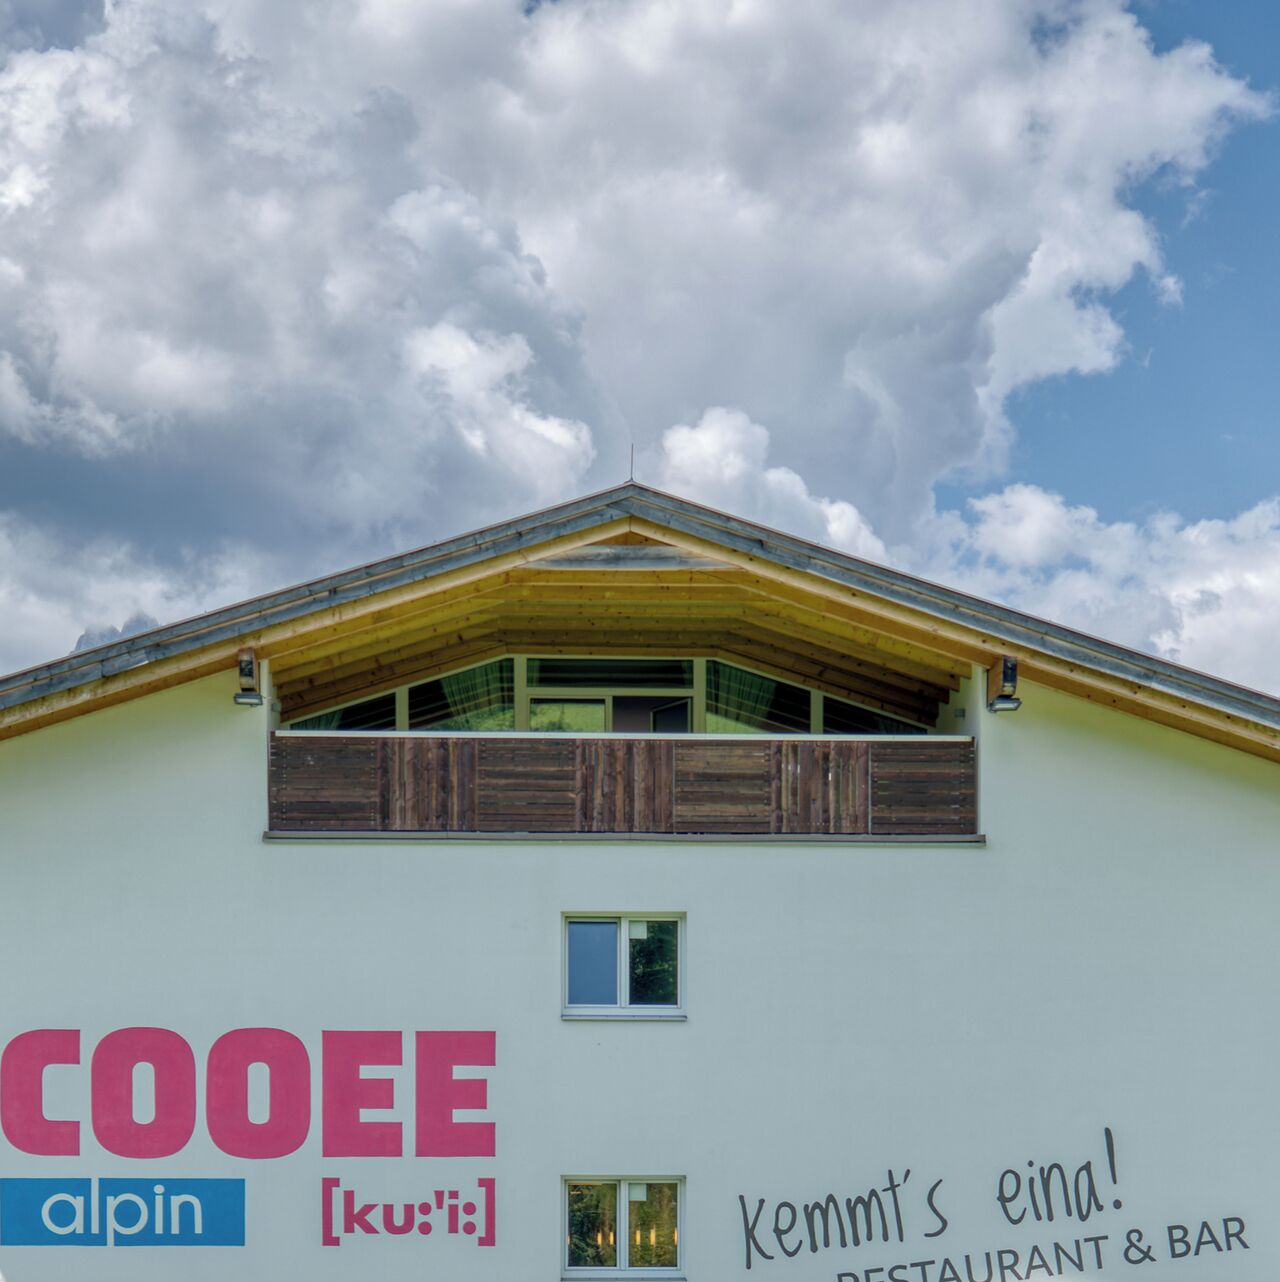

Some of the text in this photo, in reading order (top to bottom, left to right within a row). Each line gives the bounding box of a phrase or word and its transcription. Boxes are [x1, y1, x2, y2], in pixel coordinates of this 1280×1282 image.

[0, 1026, 497, 1160] COOEE
[40, 1177, 204, 1248] alpin
[996, 1126, 1123, 1226] eina!
[1123, 1228, 1157, 1265] &
[1166, 1216, 1251, 1259] BAR
